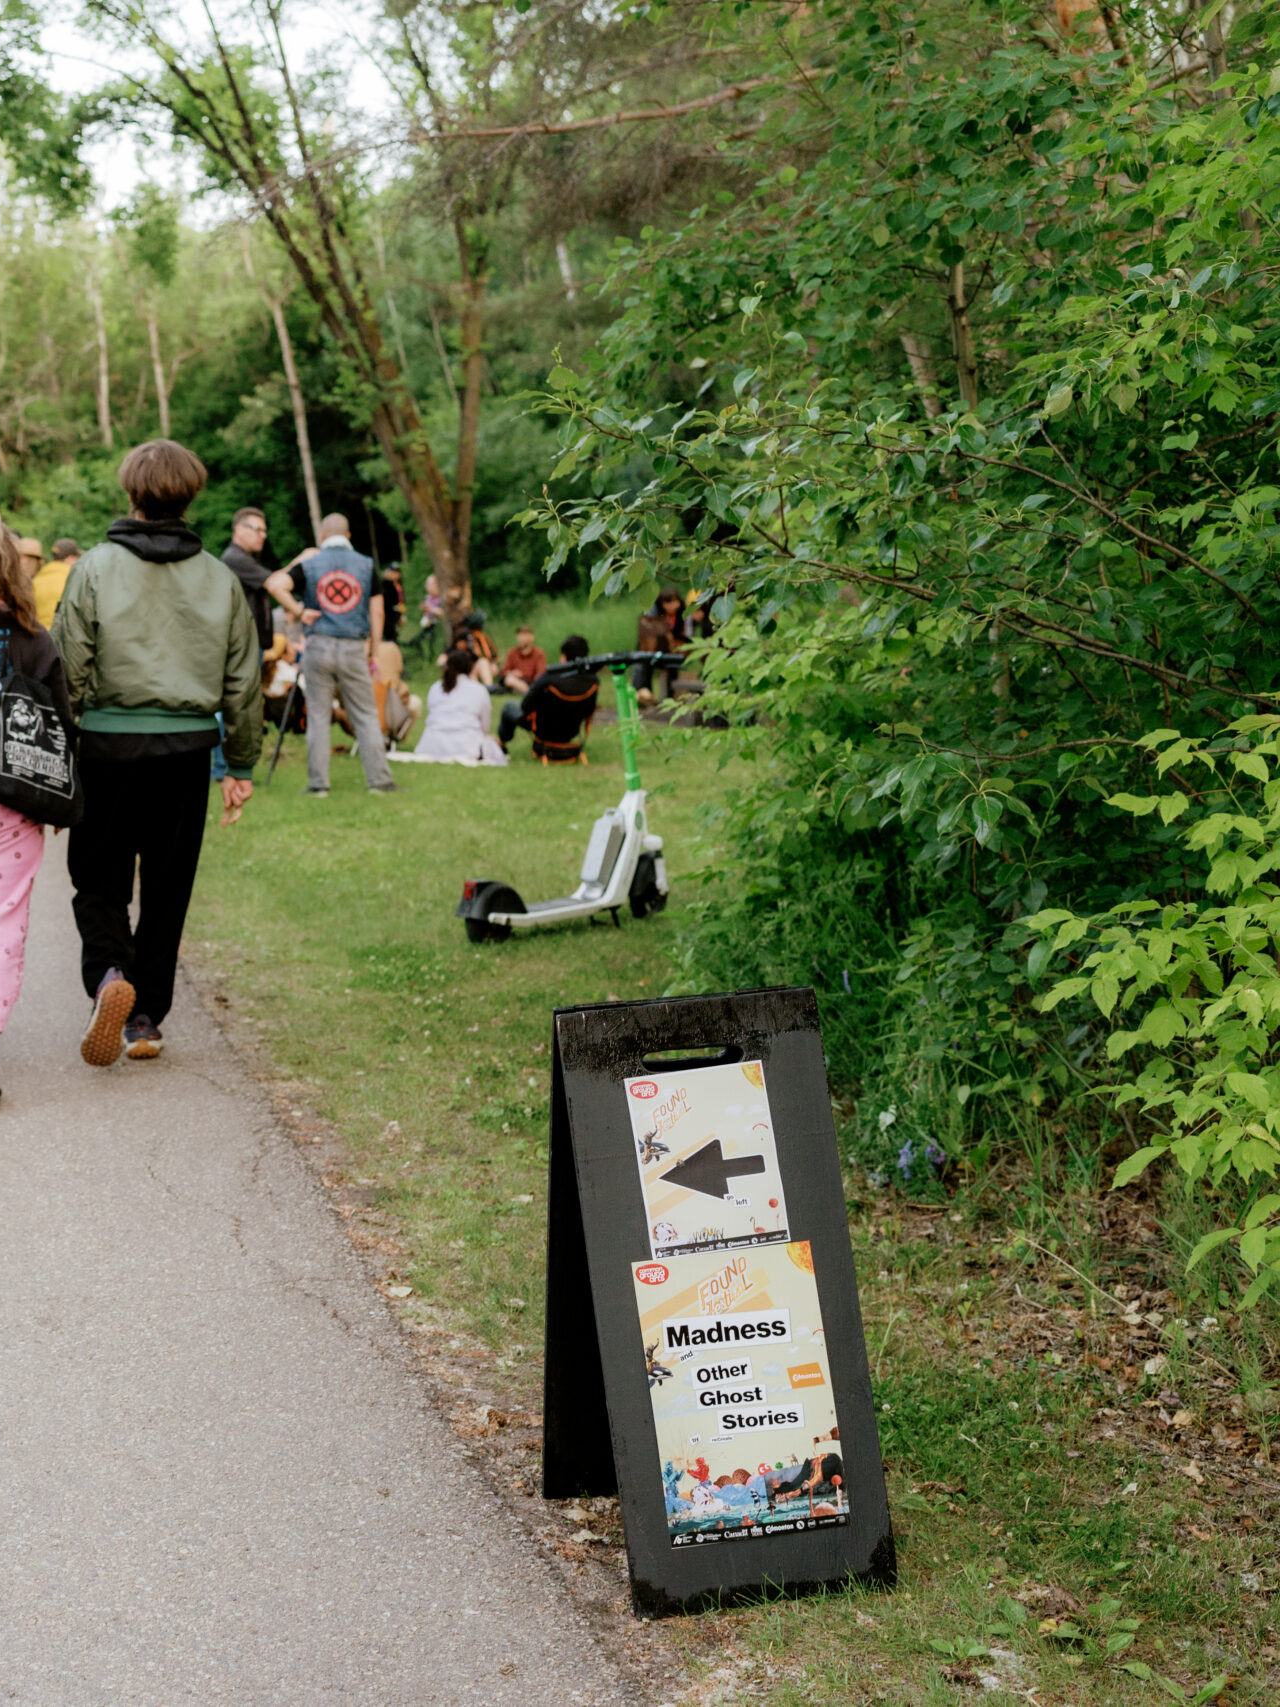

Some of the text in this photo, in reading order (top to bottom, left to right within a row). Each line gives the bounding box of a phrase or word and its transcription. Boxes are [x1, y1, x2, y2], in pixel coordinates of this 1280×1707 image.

[652, 1087, 687, 1129] FOUND
[735, 1198, 748, 1206] left
[700, 1256, 746, 1311] FOUND
[666, 1319, 787, 1348] Madness
[680, 1350, 694, 1361] and
[696, 1361, 748, 1384] Other
[699, 1386, 763, 1406] Ghost
[722, 1410, 799, 1430] Stories
[765, 1524, 794, 1534] Edmonton
